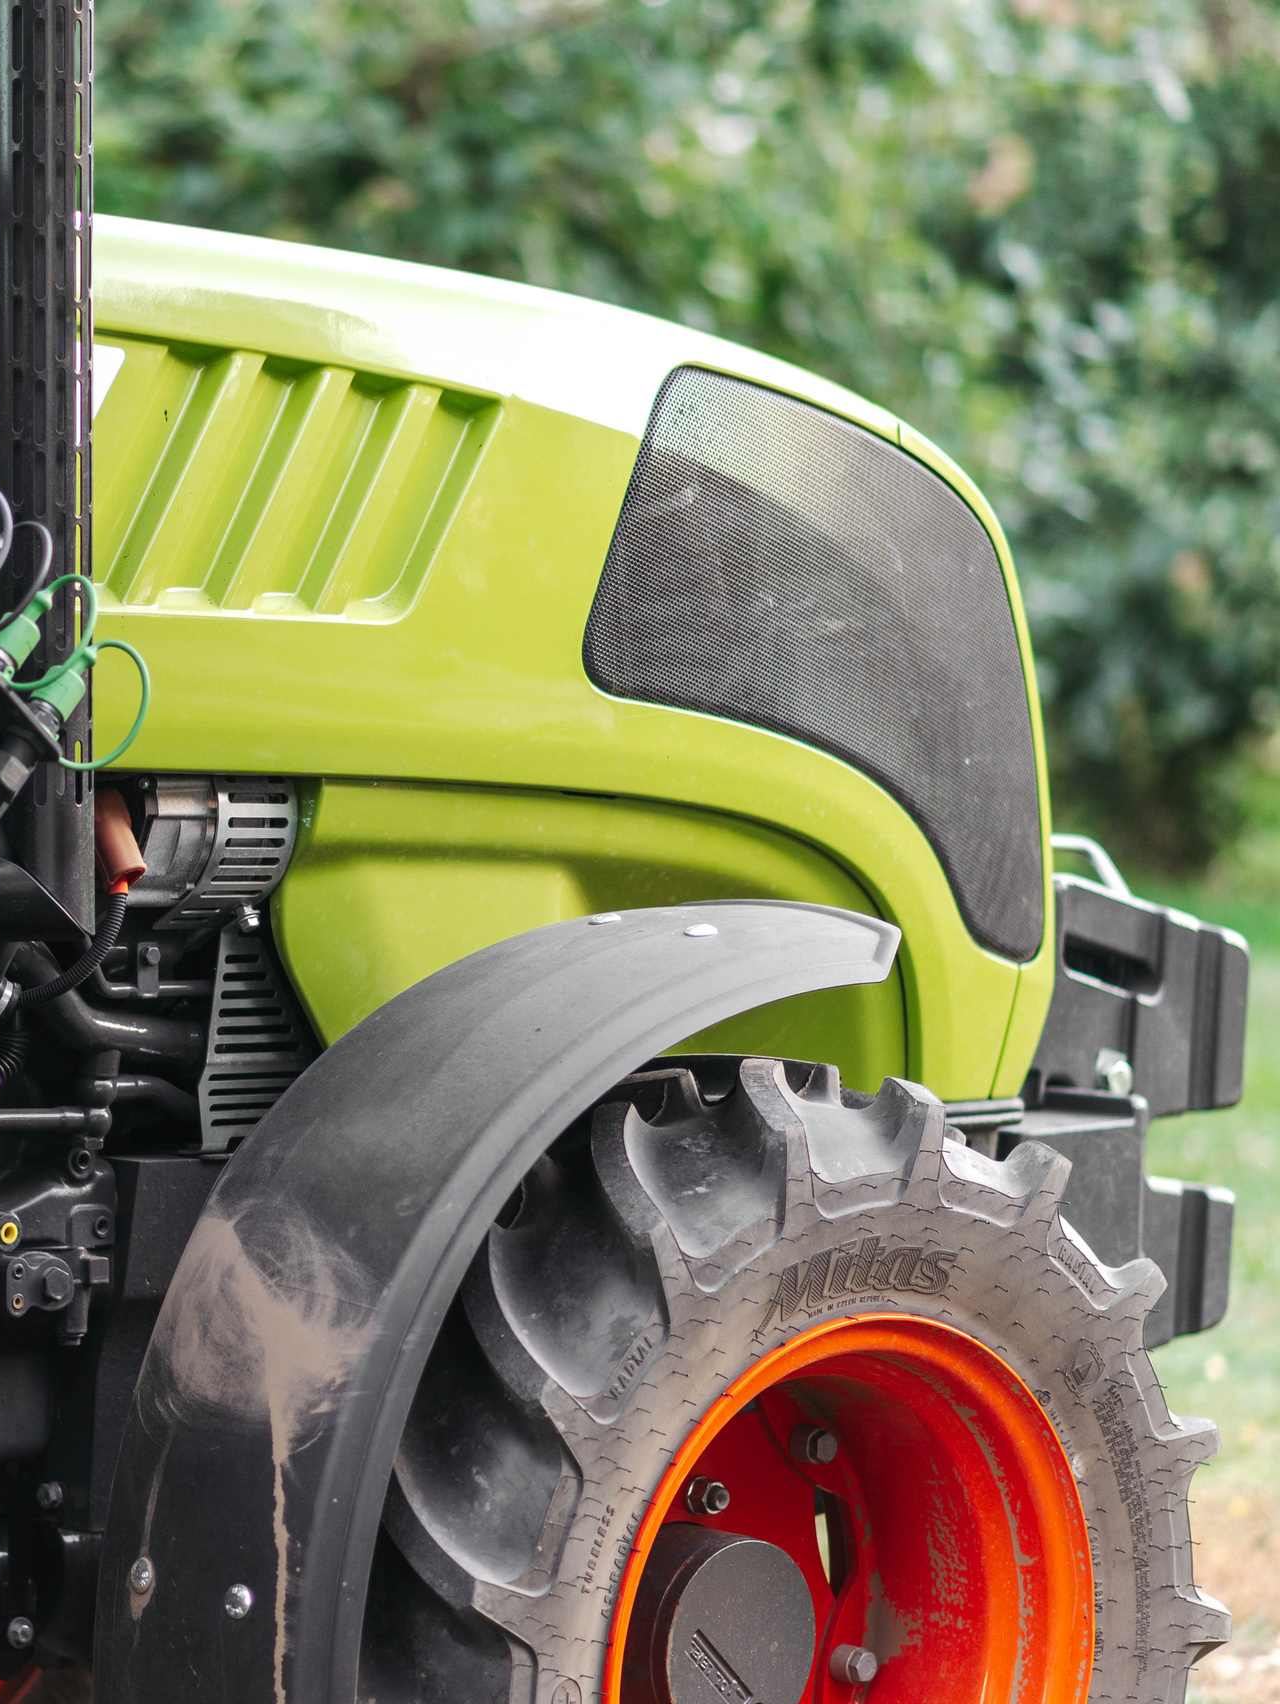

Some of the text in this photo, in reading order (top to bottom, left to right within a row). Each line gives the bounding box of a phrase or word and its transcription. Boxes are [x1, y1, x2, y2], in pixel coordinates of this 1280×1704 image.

[754, 1234, 958, 1339] Mitas
[1058, 1244, 1097, 1295] RADIAL
[808, 1294, 888, 1318] MADE IN CZECH REPUBLIC
[609, 1334, 655, 1400] RADIAL
[581, 1504, 615, 1594] TUBELESS
